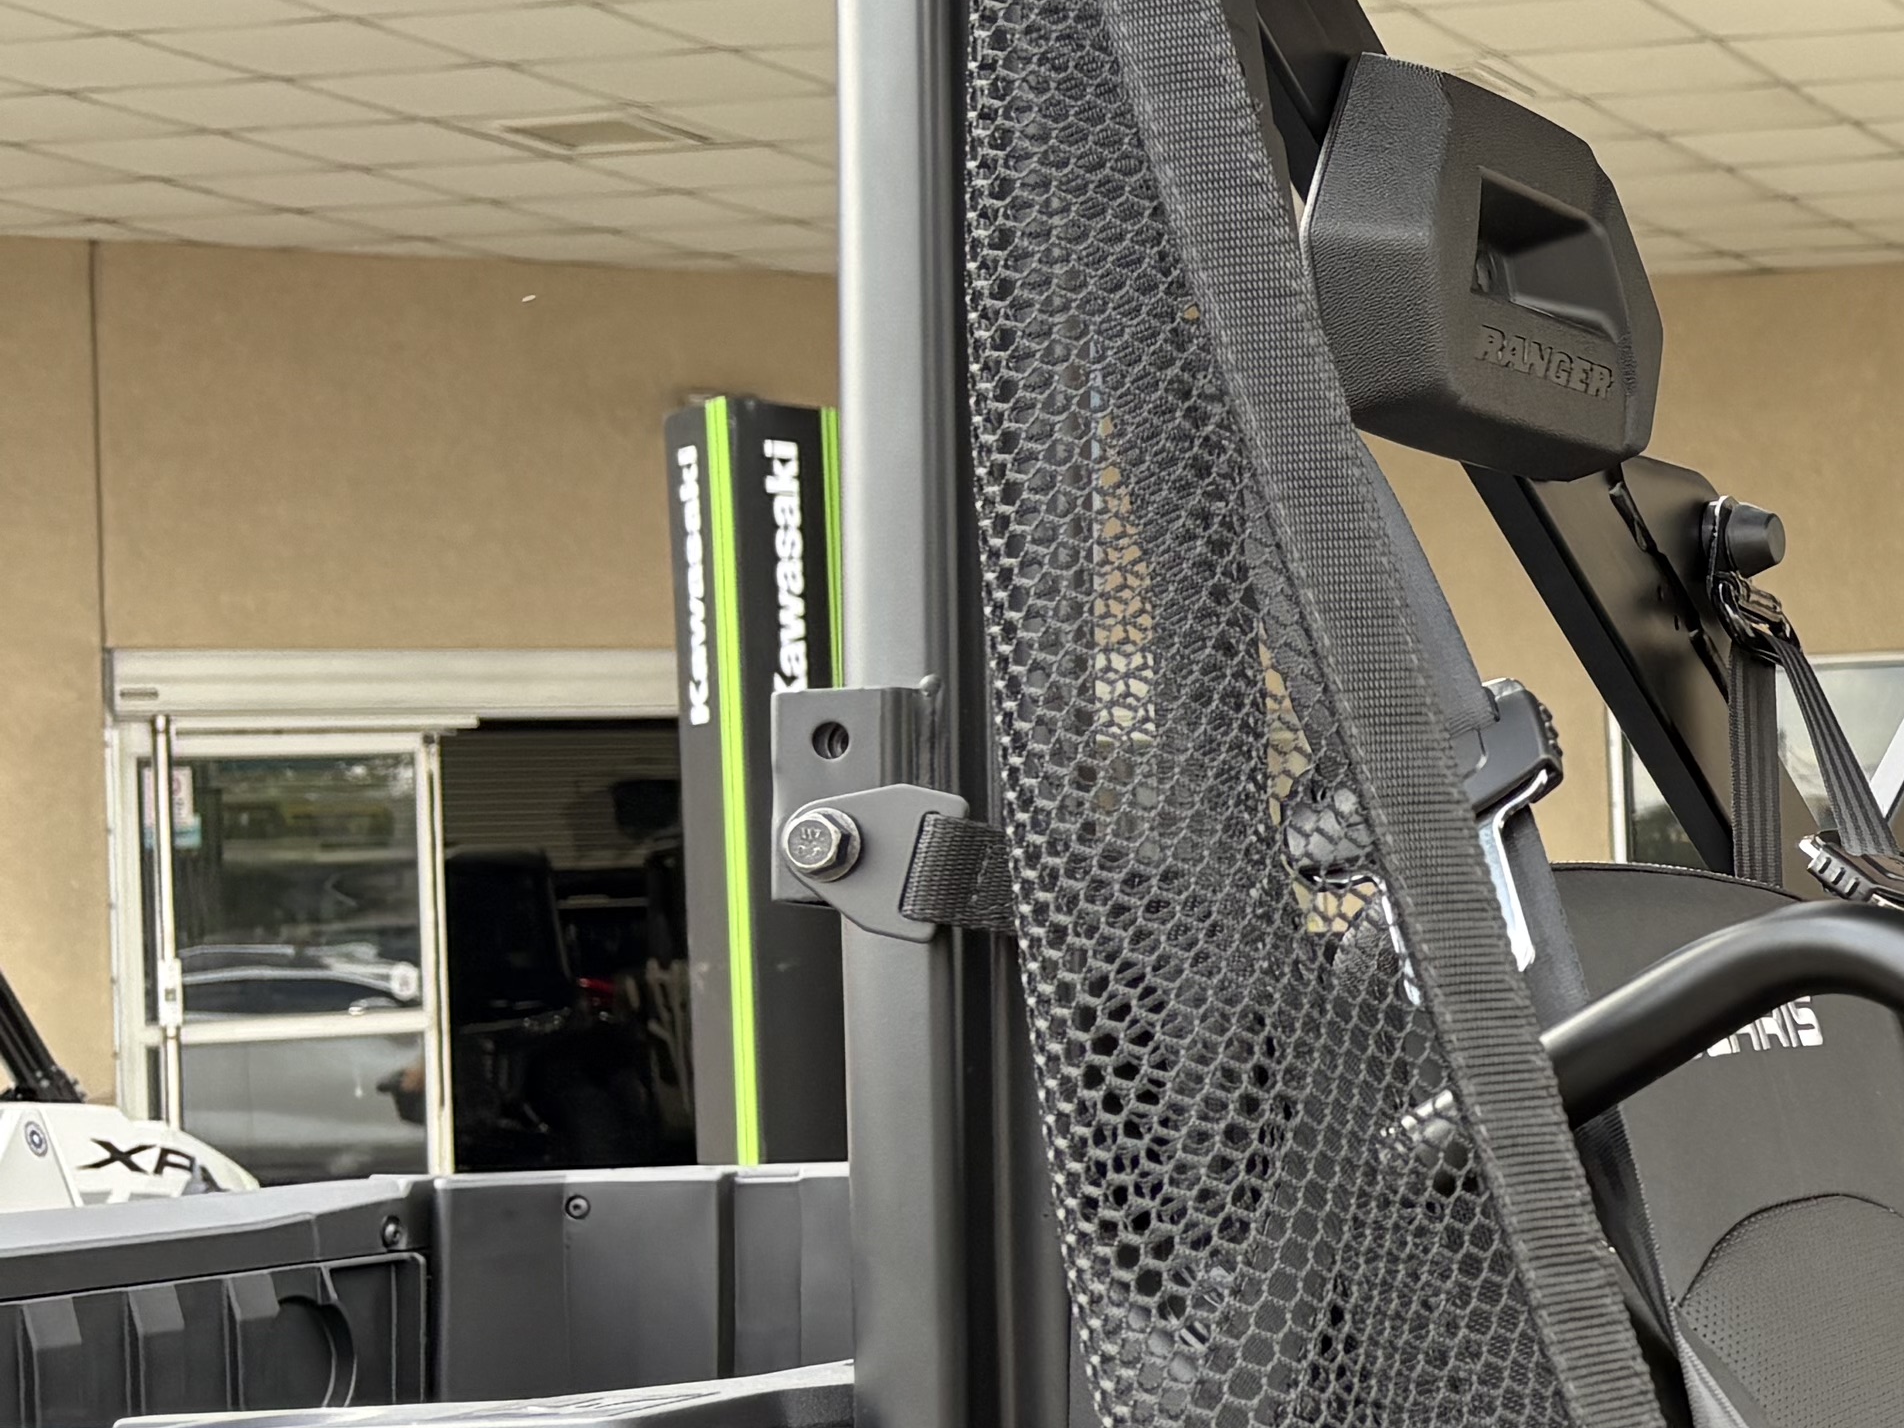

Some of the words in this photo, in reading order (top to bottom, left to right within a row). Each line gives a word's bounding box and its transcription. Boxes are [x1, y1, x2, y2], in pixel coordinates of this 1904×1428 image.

[1474, 323, 1615, 400] RANGER
[677, 445, 710, 726] Kawasaki
[1694, 995, 1824, 1059] ARIS
